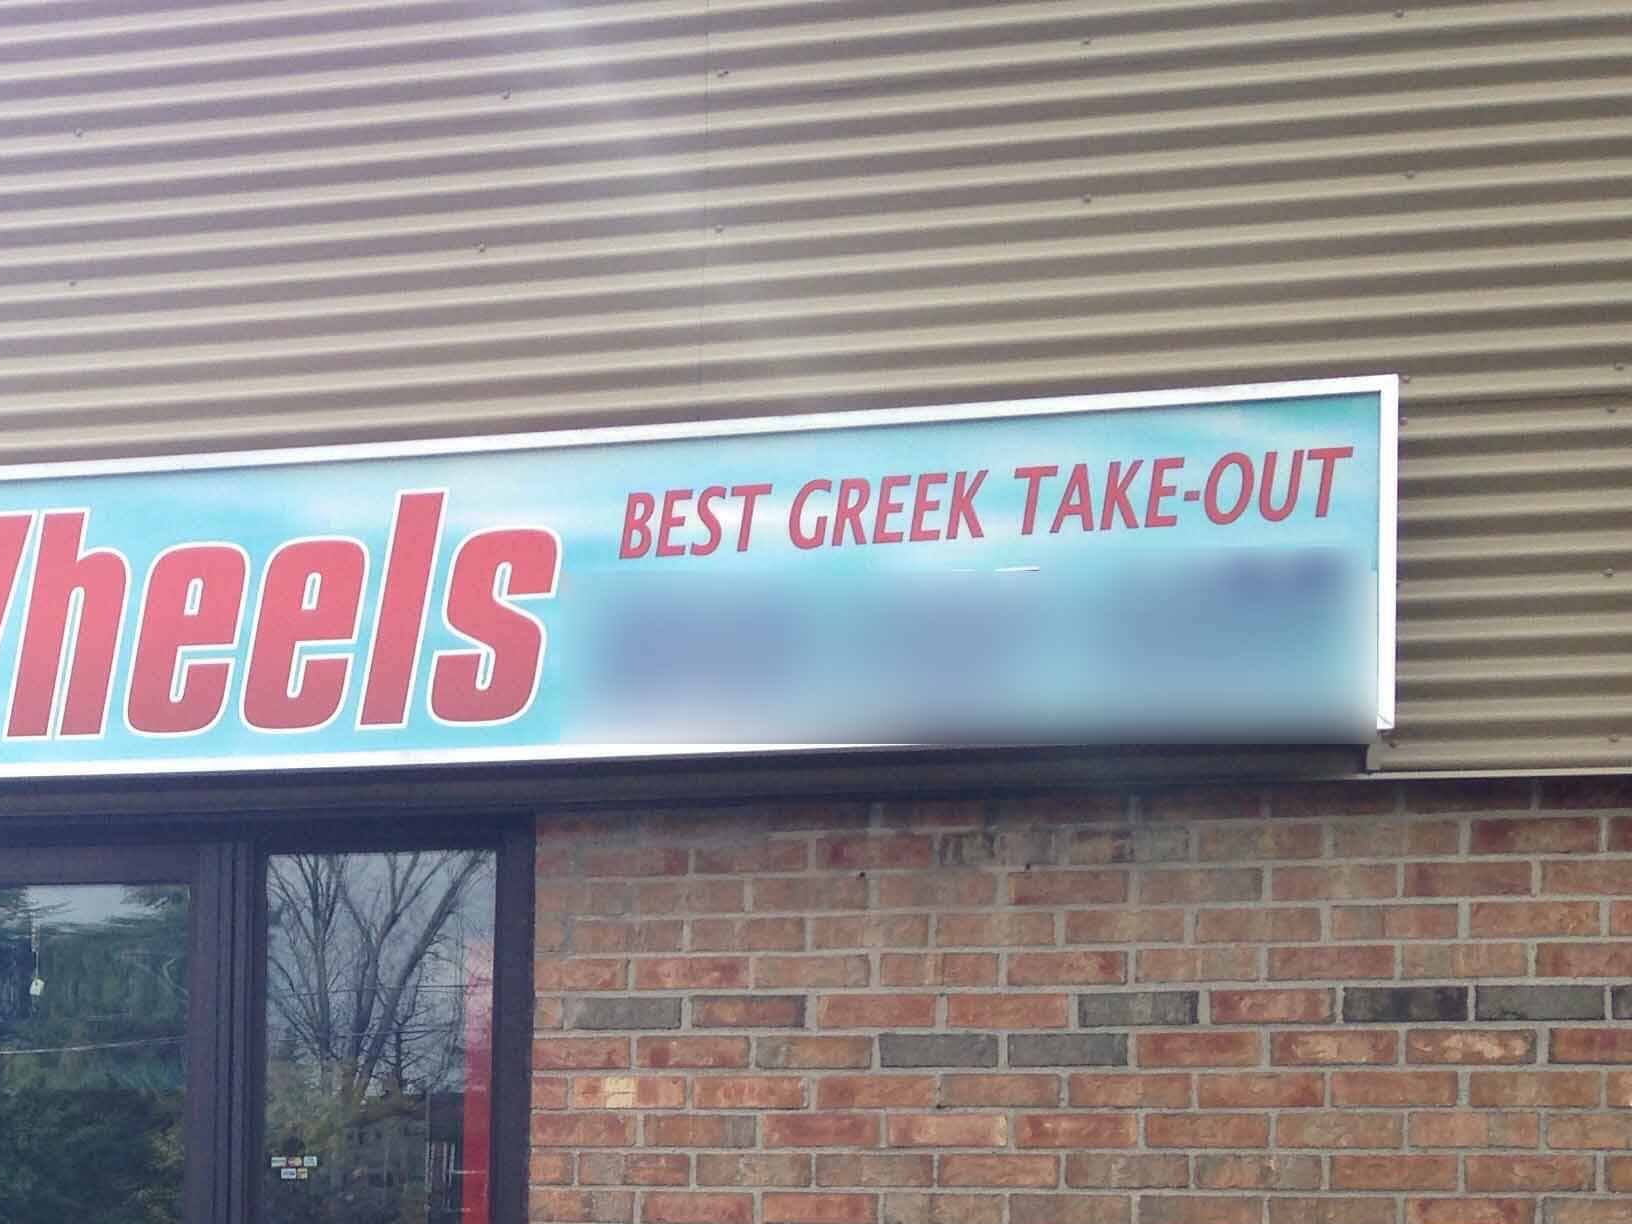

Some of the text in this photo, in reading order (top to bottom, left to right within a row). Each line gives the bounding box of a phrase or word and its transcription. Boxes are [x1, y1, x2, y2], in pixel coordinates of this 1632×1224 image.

[620, 446, 1353, 558] BEST GREEK TAKE-OUT
